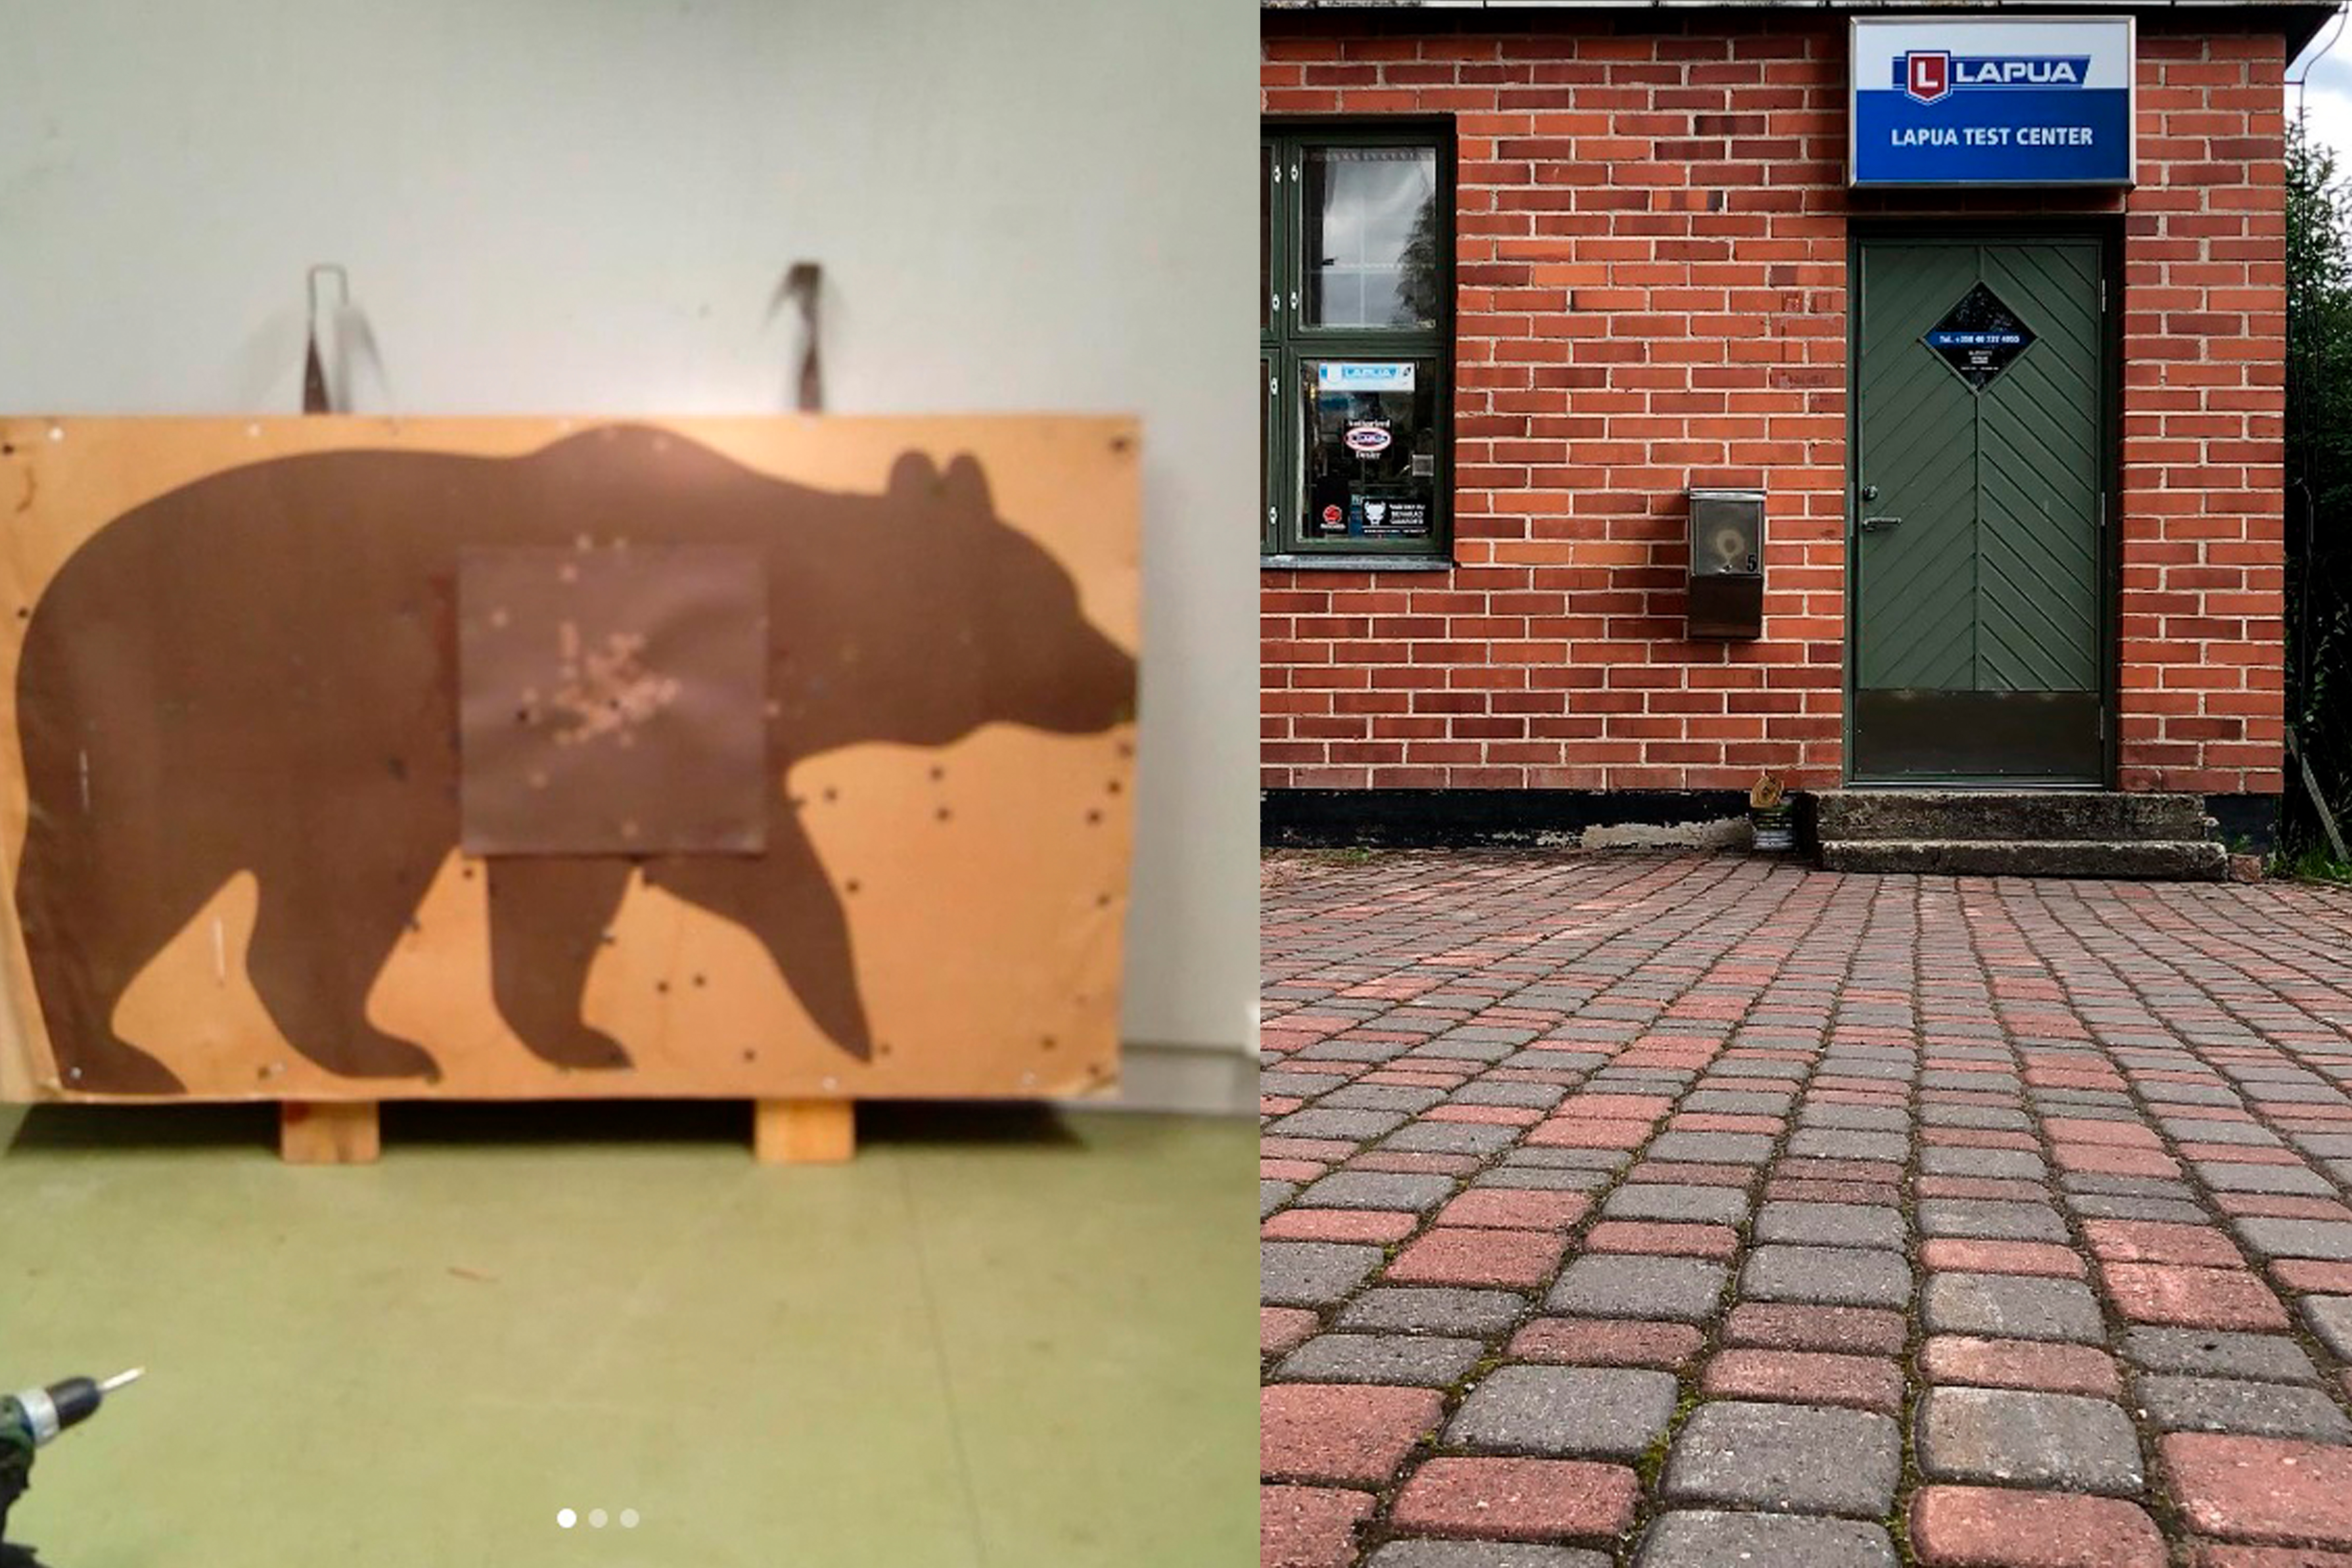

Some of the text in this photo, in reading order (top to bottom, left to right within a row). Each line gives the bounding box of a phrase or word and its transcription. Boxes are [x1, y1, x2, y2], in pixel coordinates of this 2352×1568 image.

[1918, 62, 2077, 87] L LAPUA
[1892, 127, 2093, 145] LAPUA TEST CENTER
[1748, 554, 1757, 572] 5
